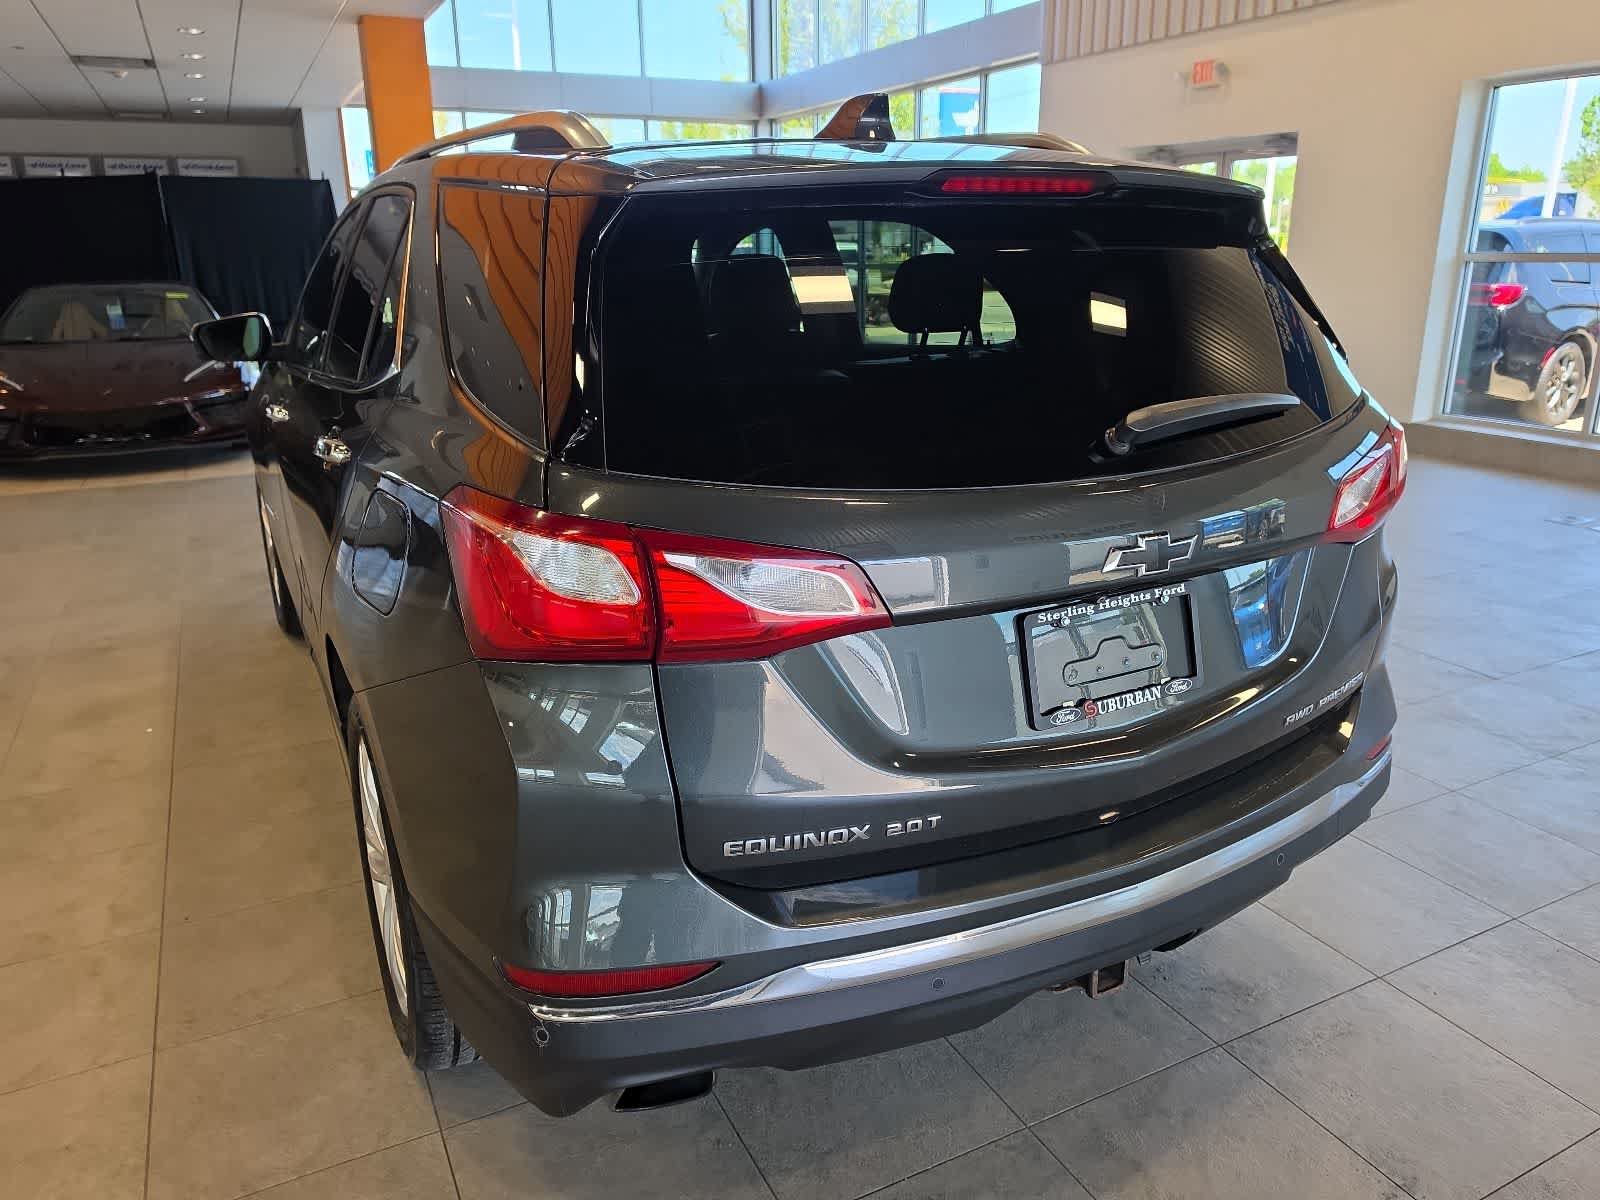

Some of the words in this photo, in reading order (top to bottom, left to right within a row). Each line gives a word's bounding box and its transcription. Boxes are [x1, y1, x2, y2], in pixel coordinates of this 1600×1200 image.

[1193, 61, 1214, 84] EXIT
[1037, 604, 1094, 624] Sterling
[1099, 592, 1151, 610] Heights
[1154, 583, 1186, 599] Ford
[1052, 708, 1079, 724] Ford
[1083, 686, 1162, 719] SUBURBAN
[1166, 679, 1191, 694] Ford
[1285, 704, 1314, 726] AWD
[723, 824, 871, 857] EQUINOX
